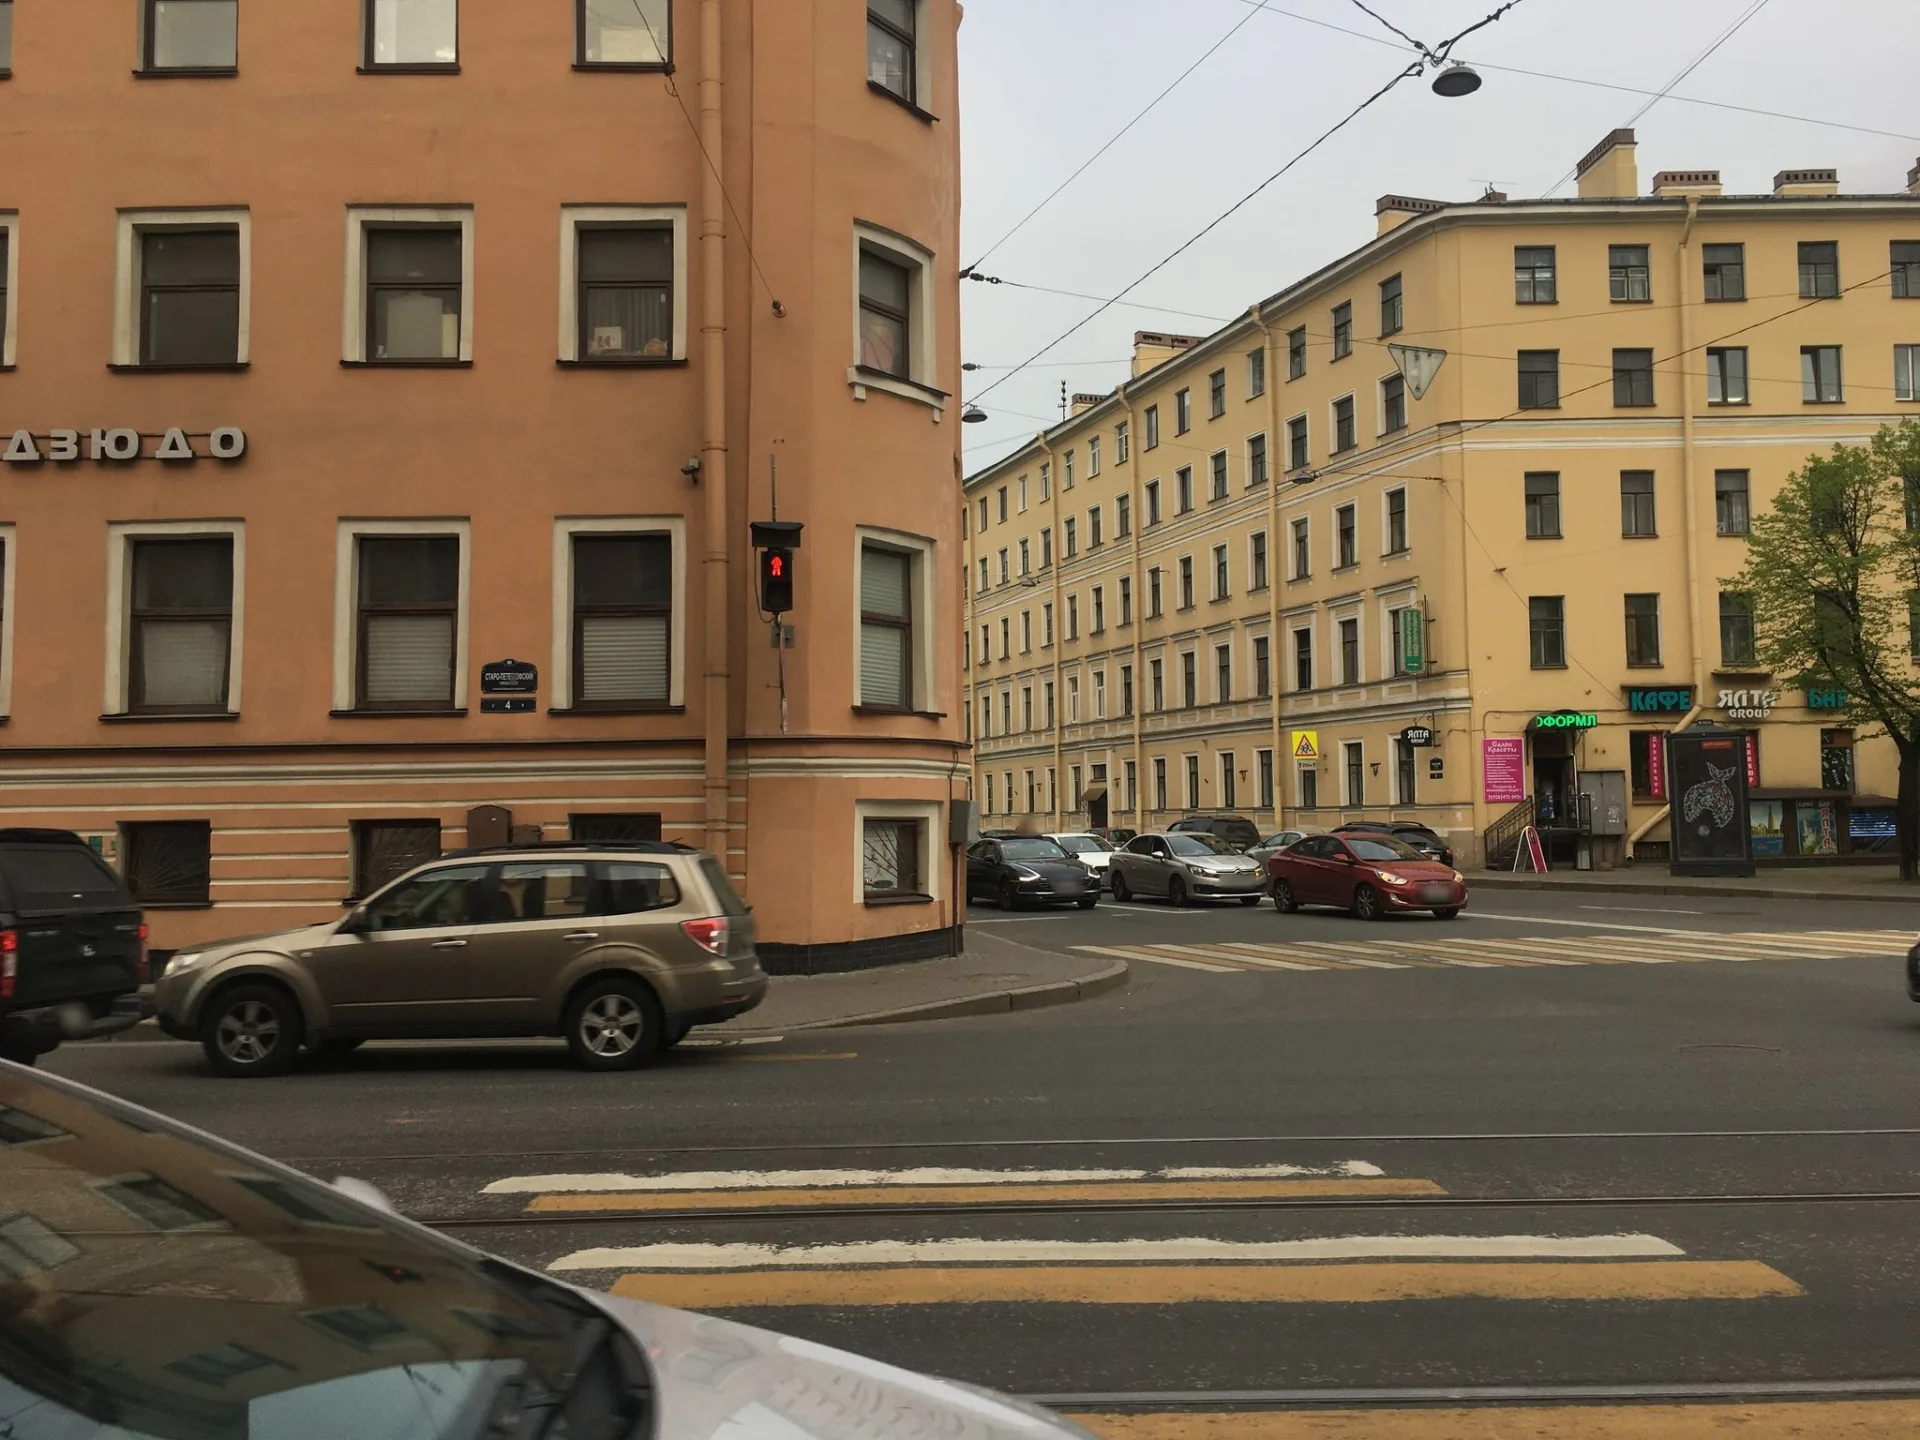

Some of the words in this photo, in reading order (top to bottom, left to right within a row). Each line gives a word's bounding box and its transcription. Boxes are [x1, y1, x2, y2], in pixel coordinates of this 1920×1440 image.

[2, 427, 246, 461] ДЗЮДО
[504, 700, 511, 709] 4
[1631, 690, 1691, 712] КАФЕ
[1717, 689, 1777, 709] ЯЛТА
[1728, 708, 1770, 719] GROUP
[1407, 730, 1430, 739] ЯЛТА
